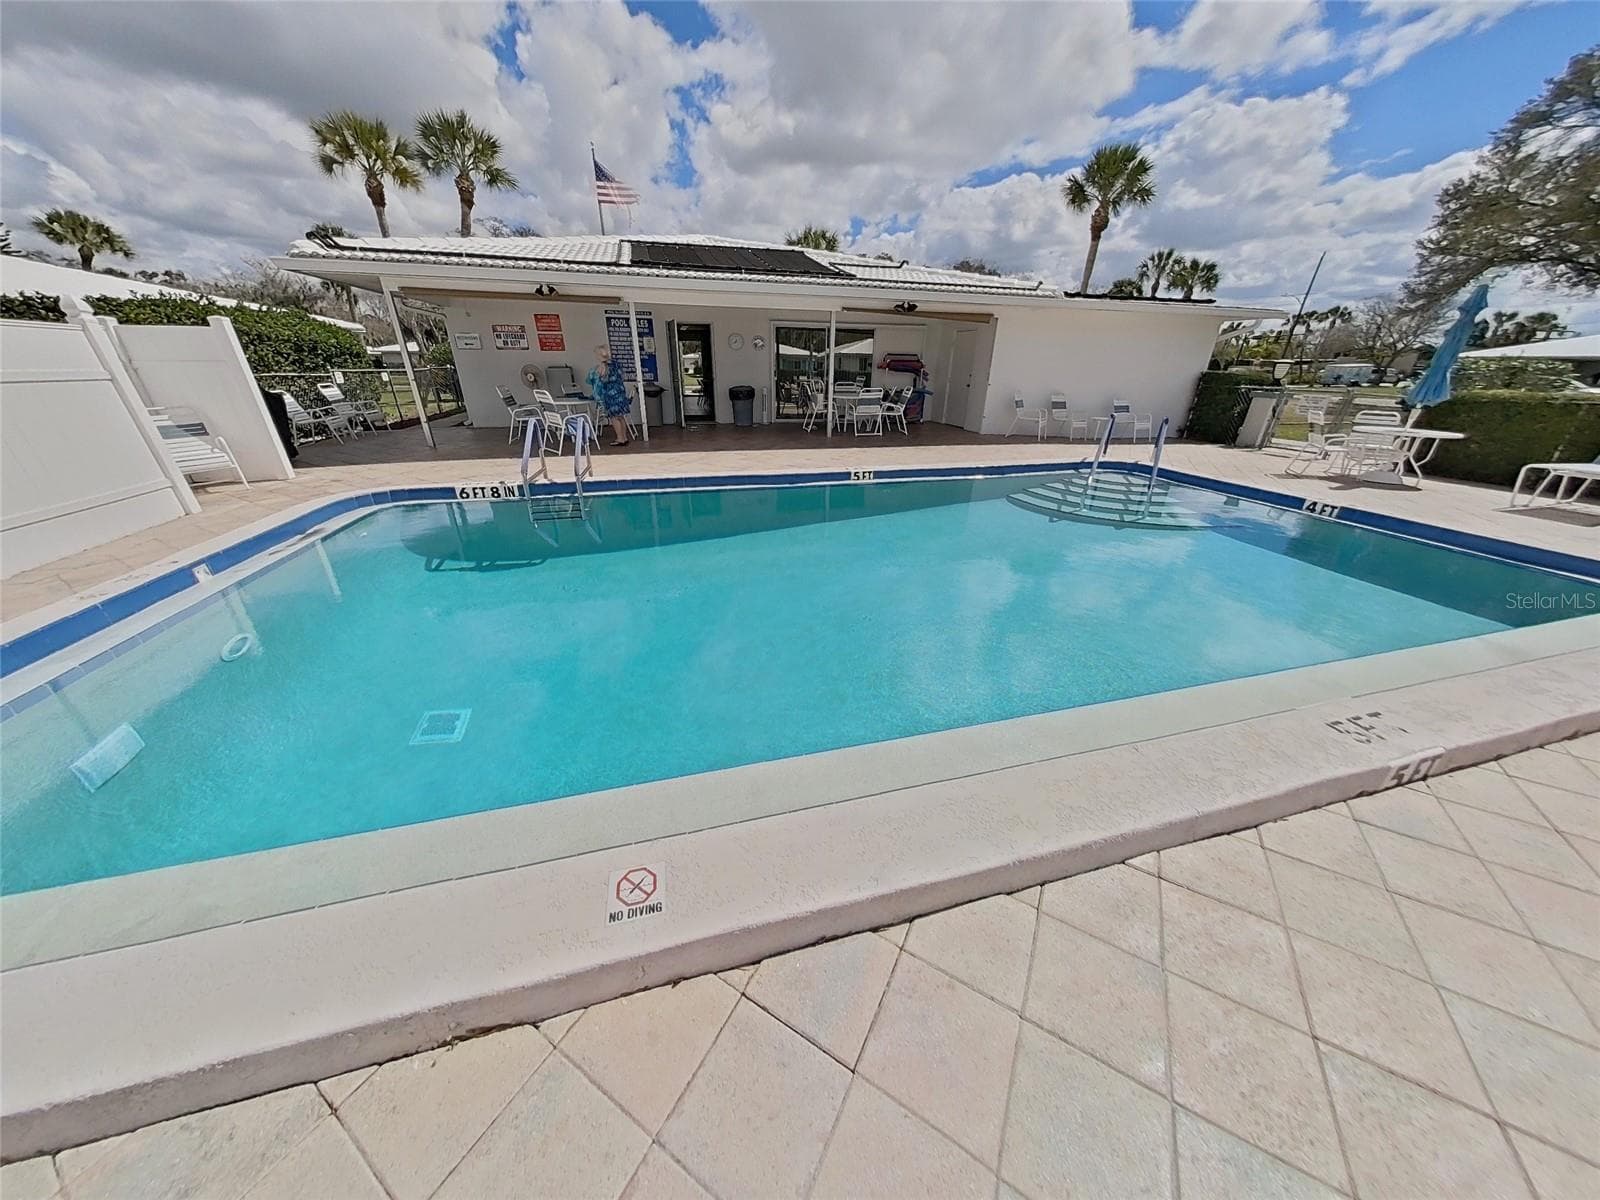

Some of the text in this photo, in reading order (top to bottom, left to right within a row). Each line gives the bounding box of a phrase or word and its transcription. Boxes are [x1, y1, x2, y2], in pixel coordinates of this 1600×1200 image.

[495, 325, 522, 333] WARNING
[611, 319, 628, 327] POOL
[853, 470, 873, 480] 5 FT
[459, 485, 516, 499] 6 FT 8 IN
[1305, 501, 1339, 517] 4 FT
[608, 901, 663, 923] NO DIVING
